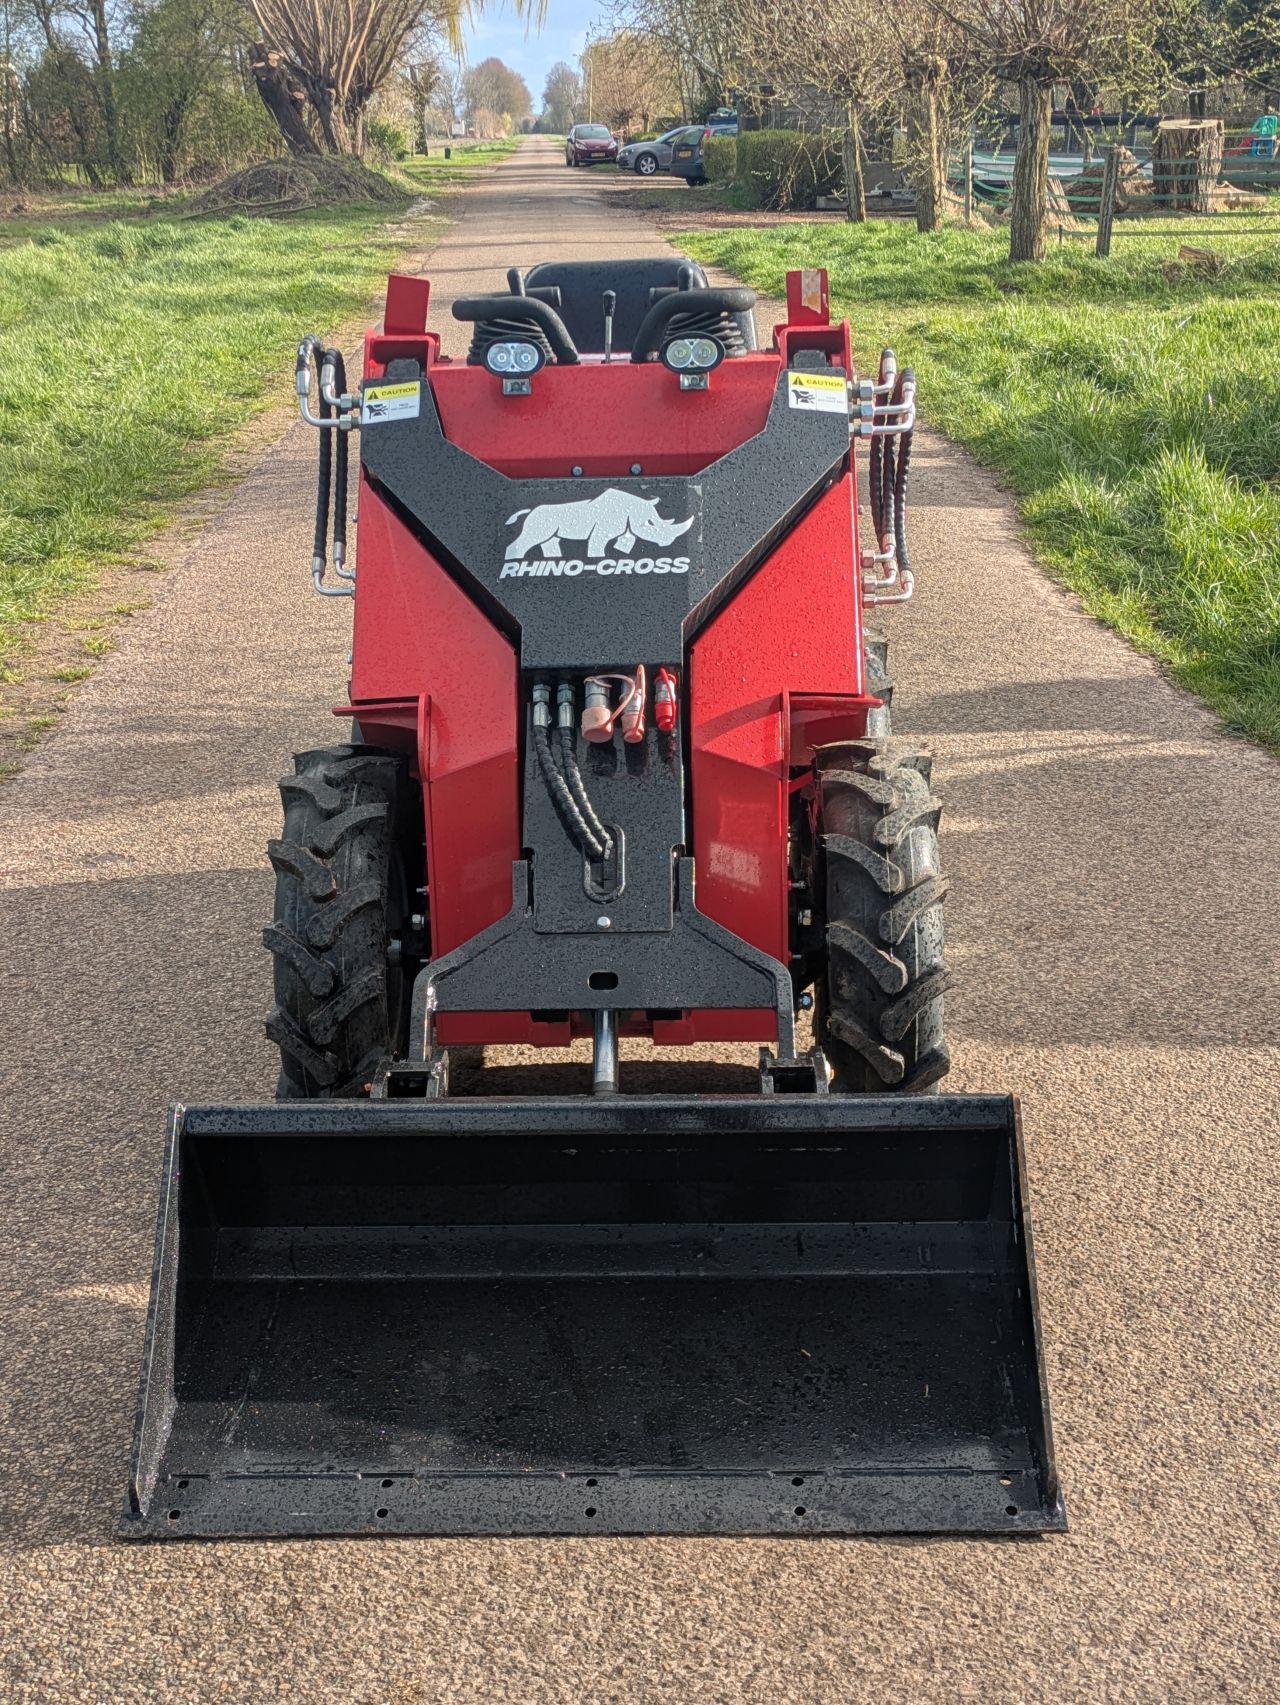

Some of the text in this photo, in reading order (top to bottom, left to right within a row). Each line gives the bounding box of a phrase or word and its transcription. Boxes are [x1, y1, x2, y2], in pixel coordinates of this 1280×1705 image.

[806, 378, 844, 388] CAUTION
[381, 386, 417, 397] CAUTION
[499, 556, 691, 580] RHINO-CROSS
